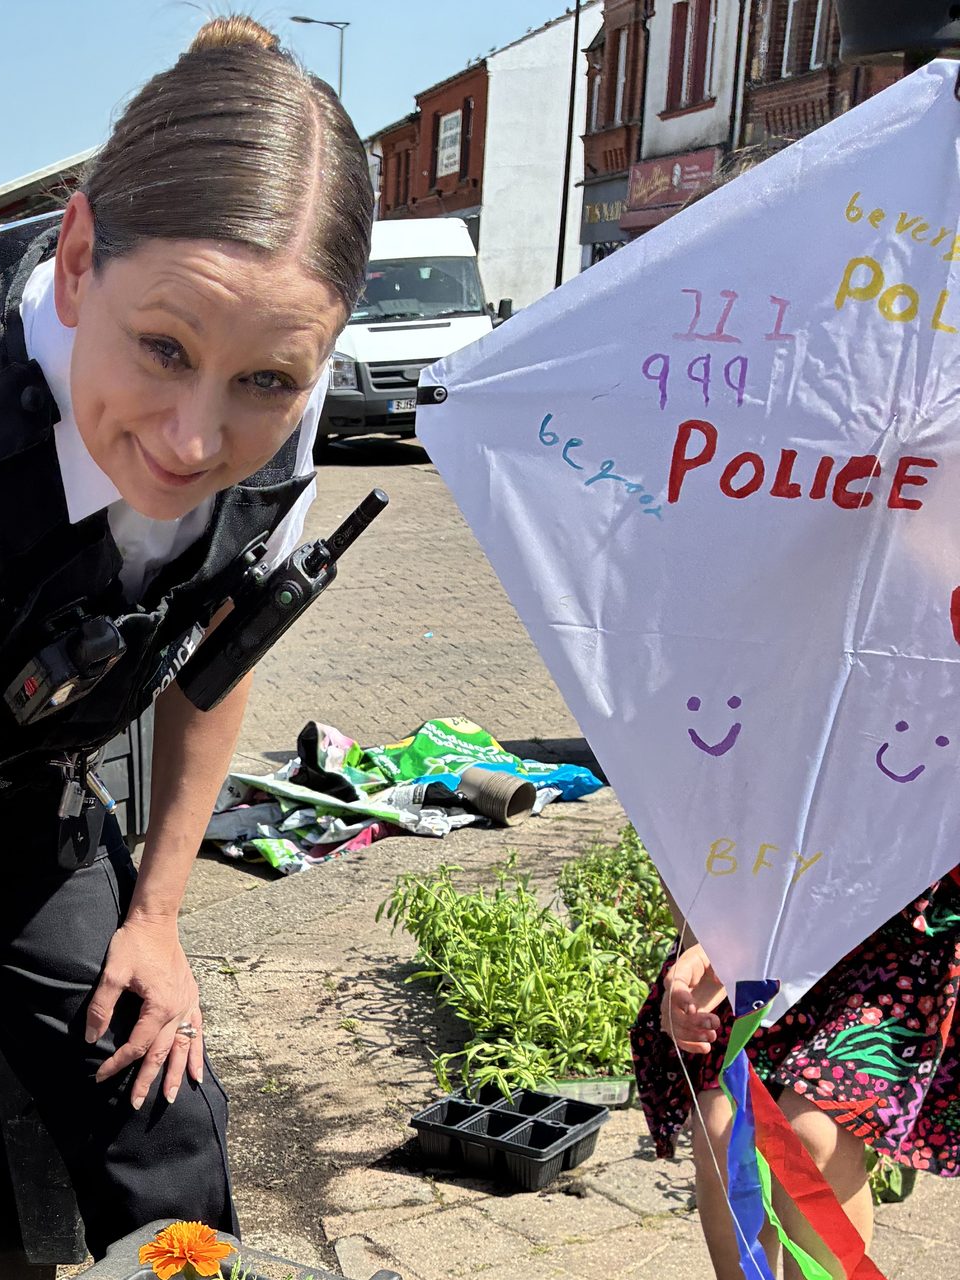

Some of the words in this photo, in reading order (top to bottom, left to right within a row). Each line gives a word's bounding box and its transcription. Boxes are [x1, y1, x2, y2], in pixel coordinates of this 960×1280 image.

[845, 191, 886, 230] be
[642, 353, 749, 410] 999
[538, 413, 585, 471] be
[667, 419, 938, 511] POLICE
[152, 635, 196, 703] POLICE
